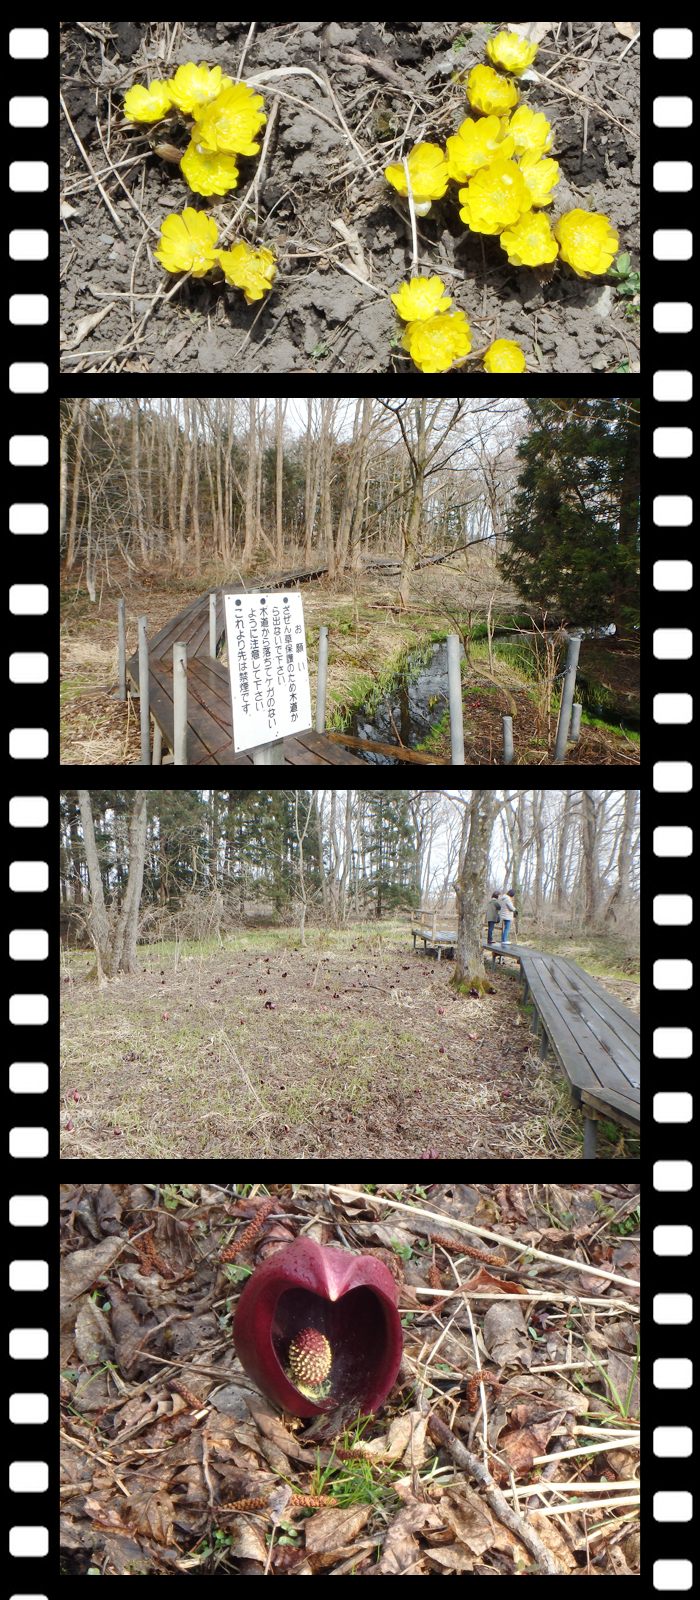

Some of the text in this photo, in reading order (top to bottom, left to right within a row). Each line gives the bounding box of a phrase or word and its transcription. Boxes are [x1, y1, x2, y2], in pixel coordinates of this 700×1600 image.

[259, 607, 277, 729] 木道から落ちてケガのない
[294, 624, 305, 672] お願い
